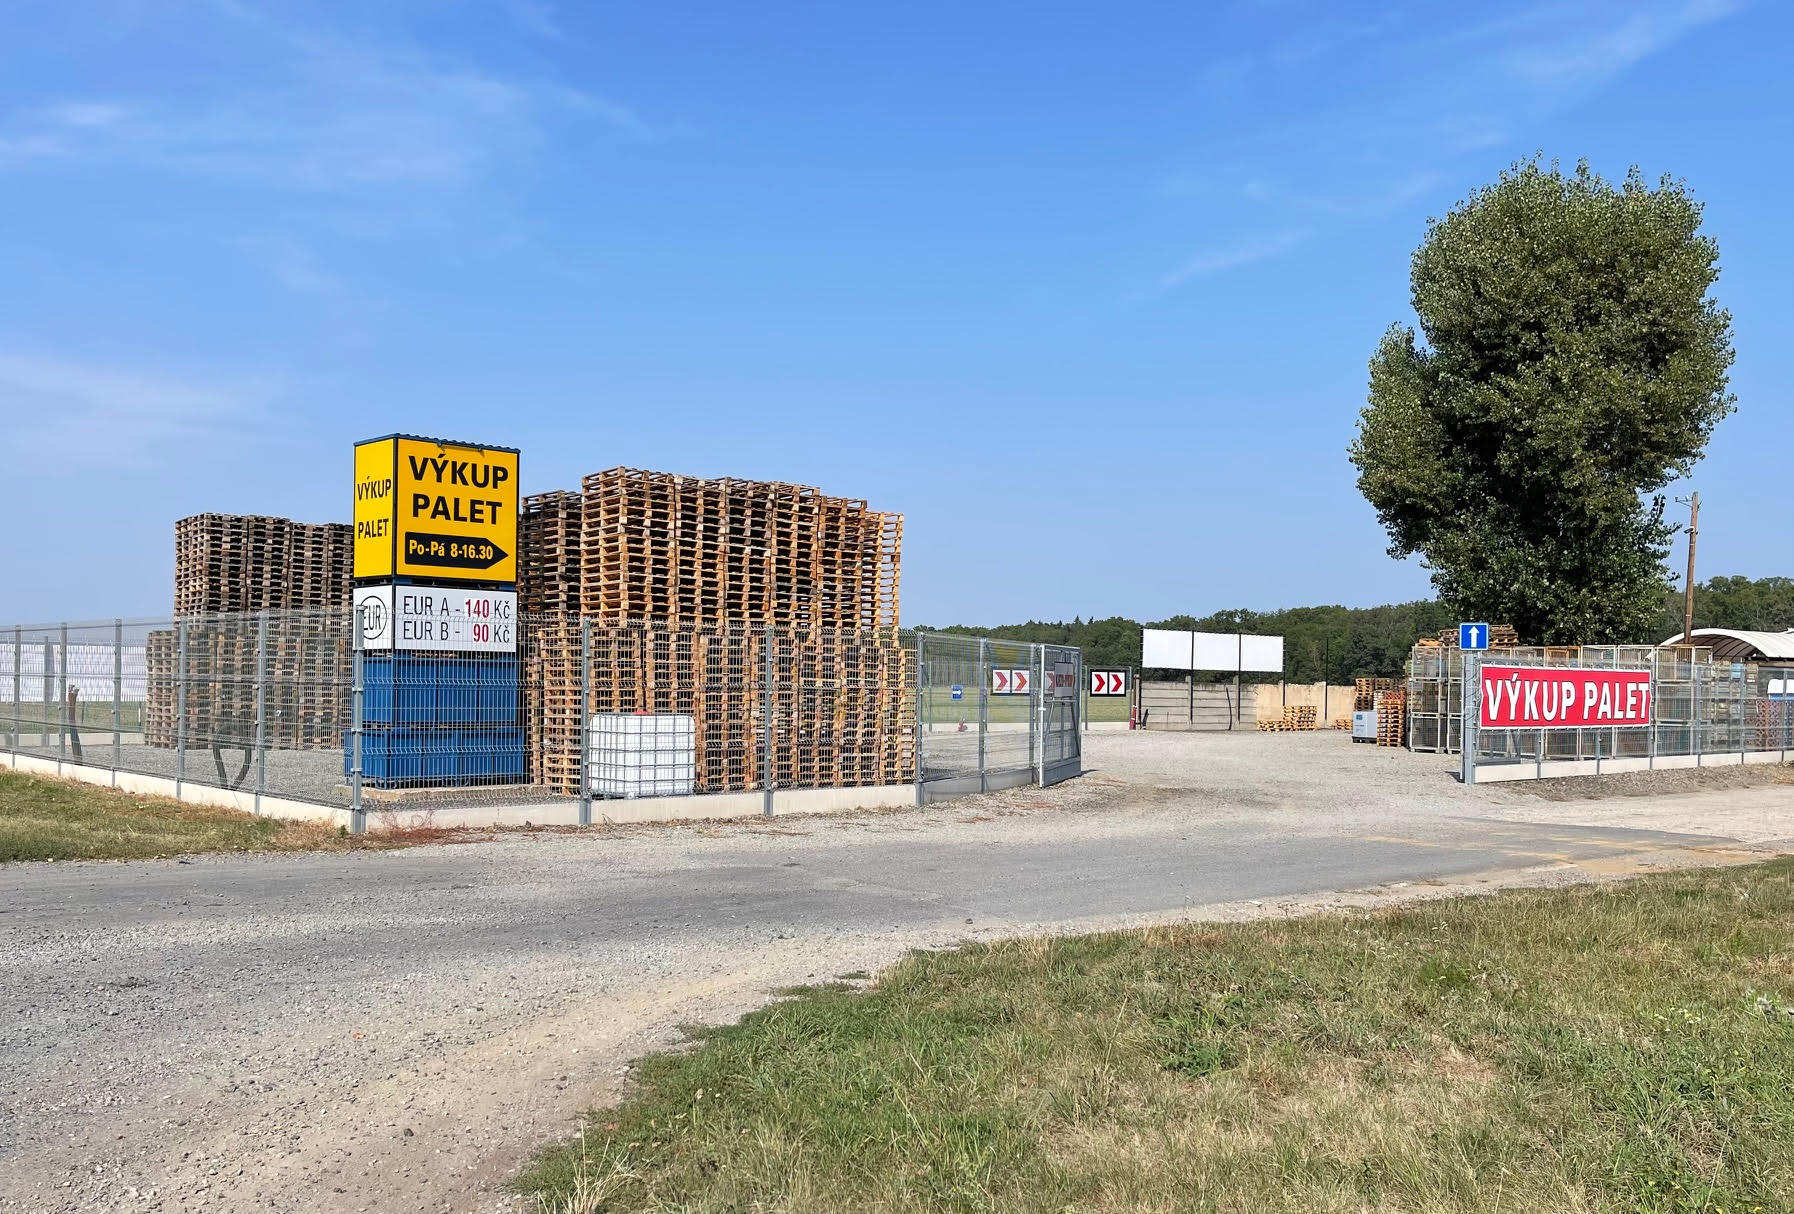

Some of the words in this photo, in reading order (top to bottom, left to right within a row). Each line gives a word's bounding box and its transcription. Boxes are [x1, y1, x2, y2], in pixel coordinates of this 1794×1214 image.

[408, 453, 509, 490] VÝKUP
[357, 475, 392, 501] VÝKUP
[412, 493, 503, 525] PALET
[358, 518, 389, 540] PALET
[409, 539, 445, 557] Po-Pá
[450, 543, 494, 560] 8-16.30
[403, 595, 433, 616] EUR
[440, 597, 450, 617] A
[465, 598, 490, 619] 140
[494, 600, 510, 619] Kč
[403, 620, 433, 640] EUR
[440, 621, 449, 641] B
[473, 623, 489, 643] 90
[493, 624, 510, 643] Kč
[1484, 672, 1577, 722] VÝKUP
[1582, 680, 1650, 721] PALET
